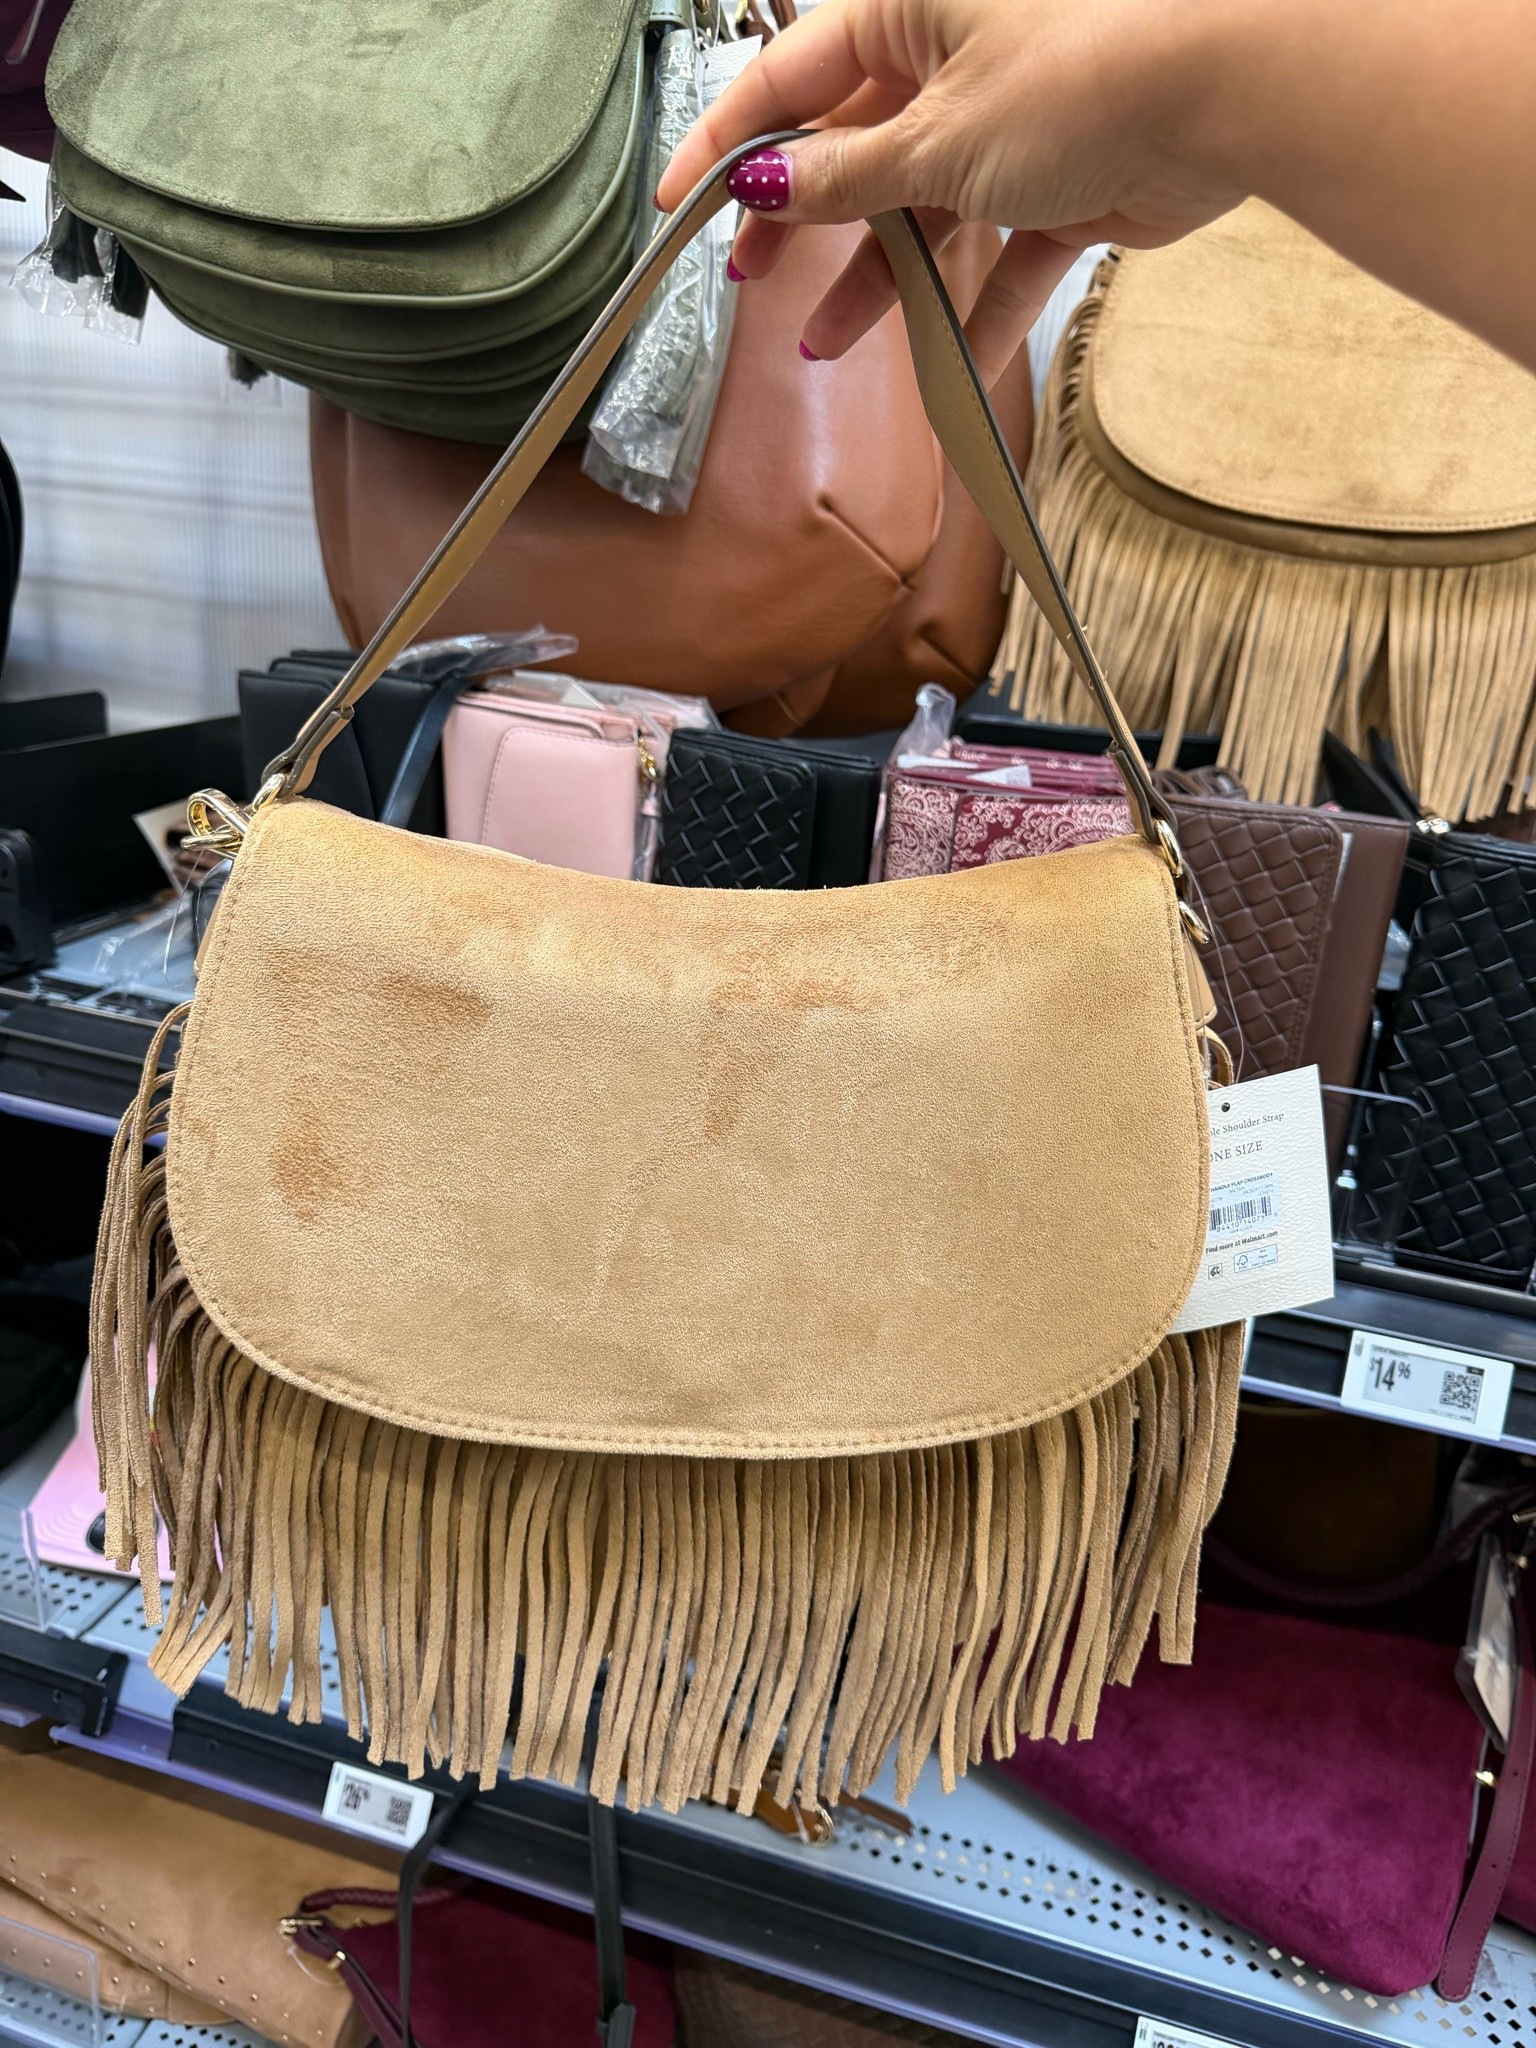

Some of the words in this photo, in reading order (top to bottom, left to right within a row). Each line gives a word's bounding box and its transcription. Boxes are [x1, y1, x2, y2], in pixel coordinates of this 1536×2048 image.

[1222, 1118, 1260, 1134] Shoulder
[1262, 1113, 1284, 1124] Strap
[1235, 1140, 1263, 1157] SIZE
[1210, 1183, 1231, 1193] HANDLE
[1230, 1179, 1244, 1188] FLAP
[1243, 1172, 1274, 1184] CROSSBODY
[1205, 1244, 1219, 1255] Find
[1219, 1241, 1235, 1251] more
[1234, 1239, 1242, 1247] at
[1241, 1230, 1279, 1245] Walmart.com
